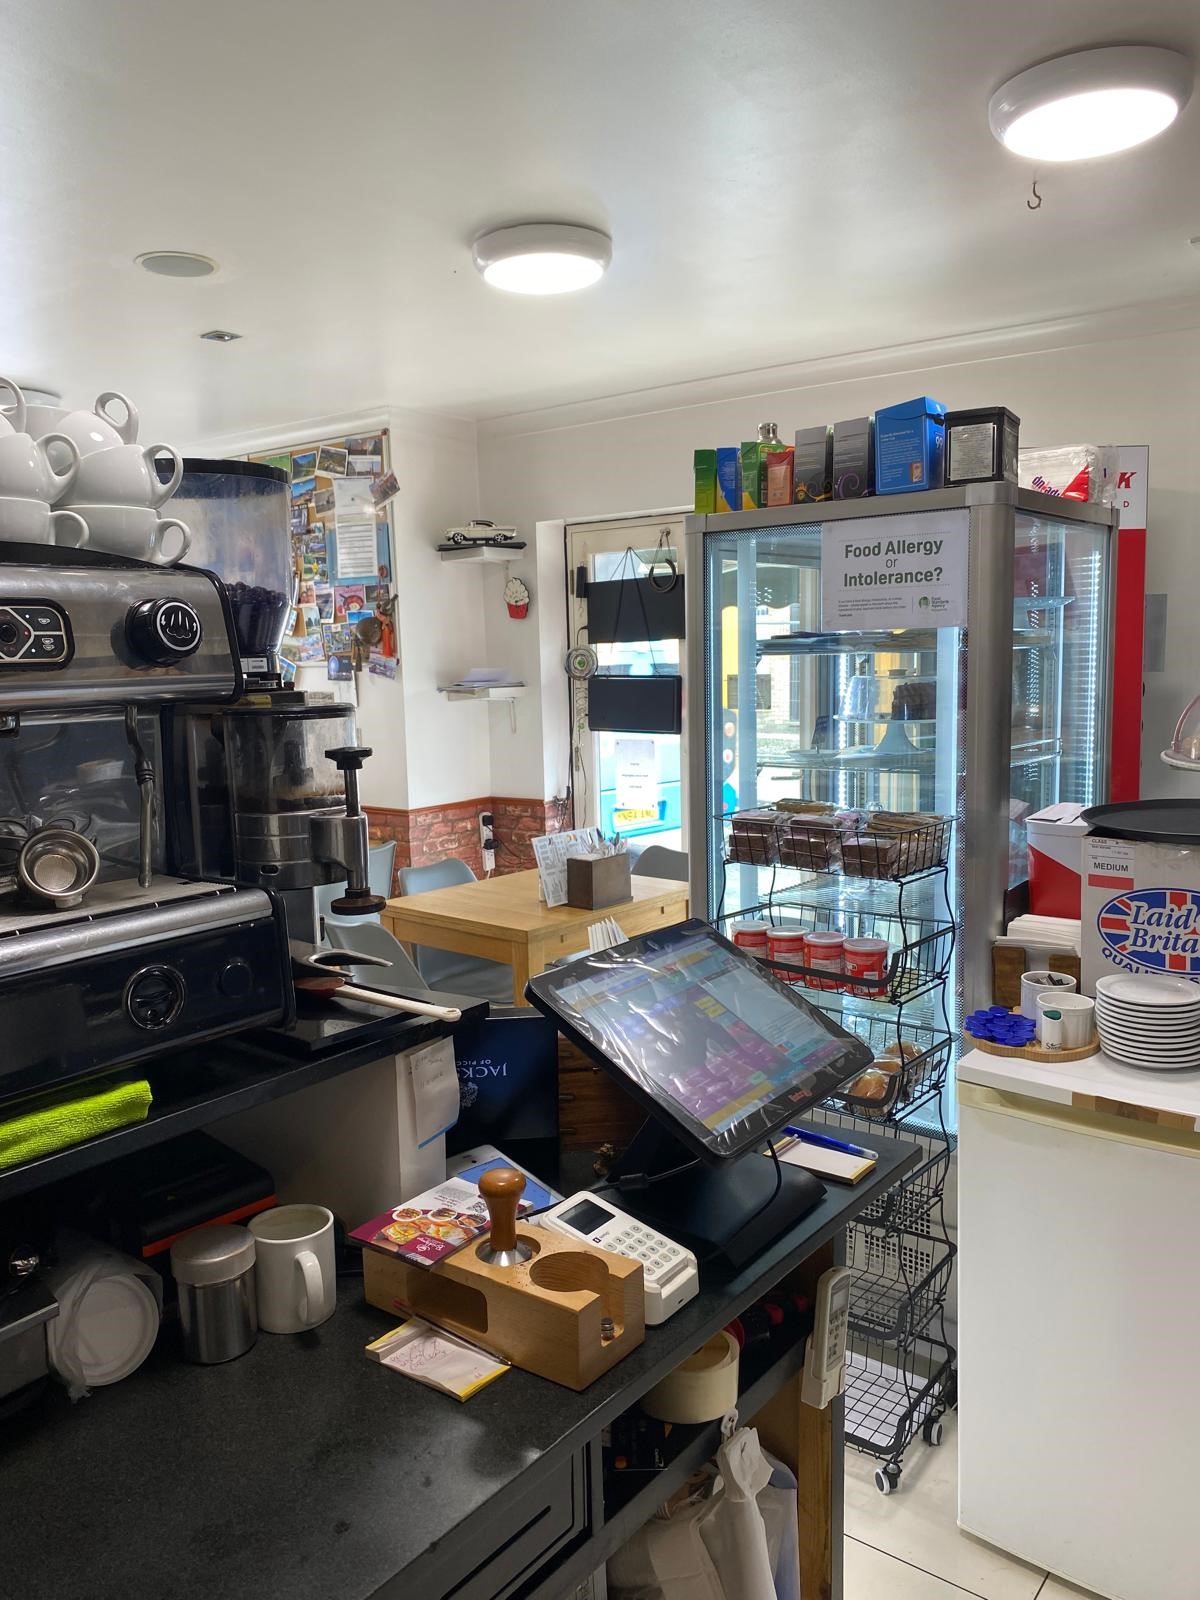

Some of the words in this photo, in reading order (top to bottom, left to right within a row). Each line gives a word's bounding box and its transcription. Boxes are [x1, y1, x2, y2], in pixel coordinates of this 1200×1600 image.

[845, 541, 881, 558] Food
[885, 540, 943, 555] Allergy
[885, 558, 899, 569] or
[844, 567, 943, 587] Intolerance?
[1093, 861, 1129, 873] MEDIUM
[1130, 904, 1194, 930] Laid
